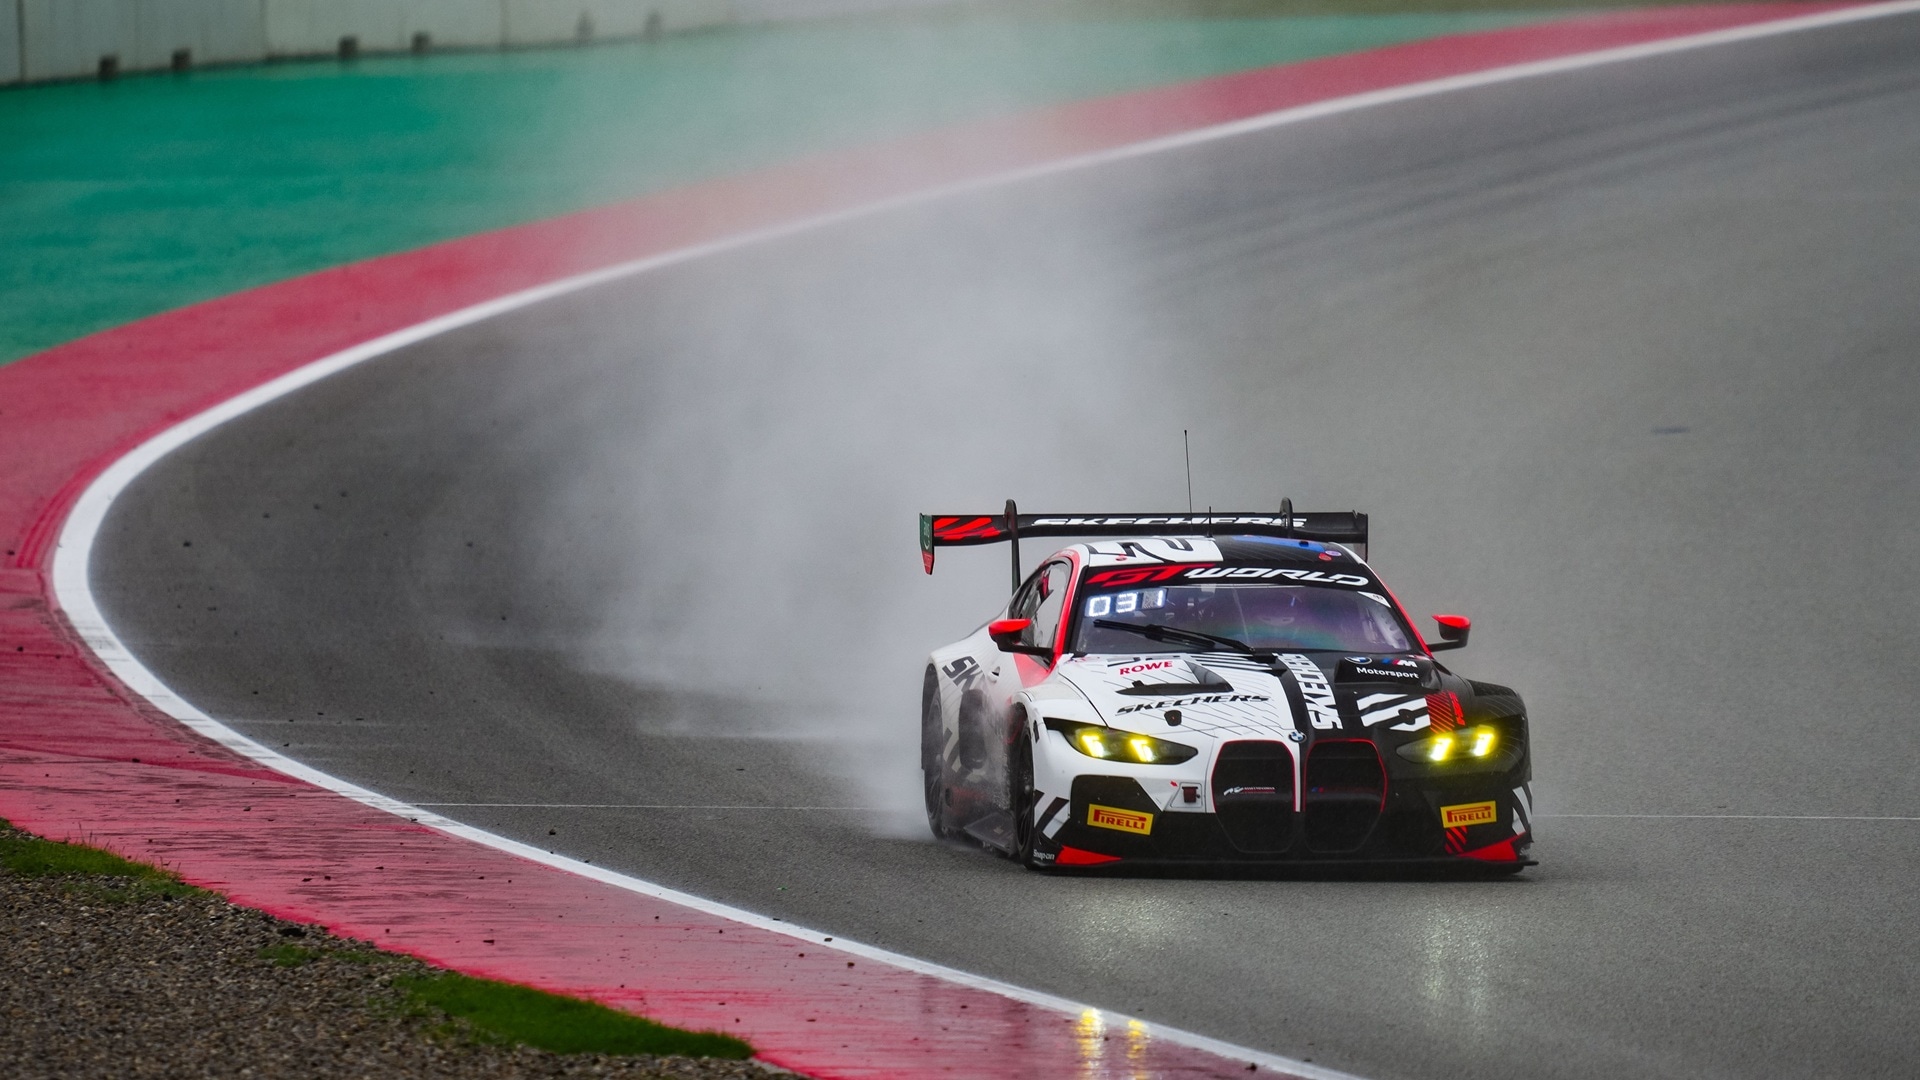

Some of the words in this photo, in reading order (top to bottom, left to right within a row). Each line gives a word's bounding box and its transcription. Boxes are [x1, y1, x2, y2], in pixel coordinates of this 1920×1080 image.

[1031, 517, 1307, 527] SKECHERS
[1085, 563, 1216, 587] GT
[1184, 567, 1369, 586] WORLD
[1088, 590, 1164, 617] 031
[1119, 661, 1173, 675] ROWE
[1356, 666, 1420, 679] Motorsport
[1115, 694, 1270, 715] SKECHERS
[1093, 809, 1147, 830] PIRELLI
[1446, 805, 1492, 823] PIRELLI
